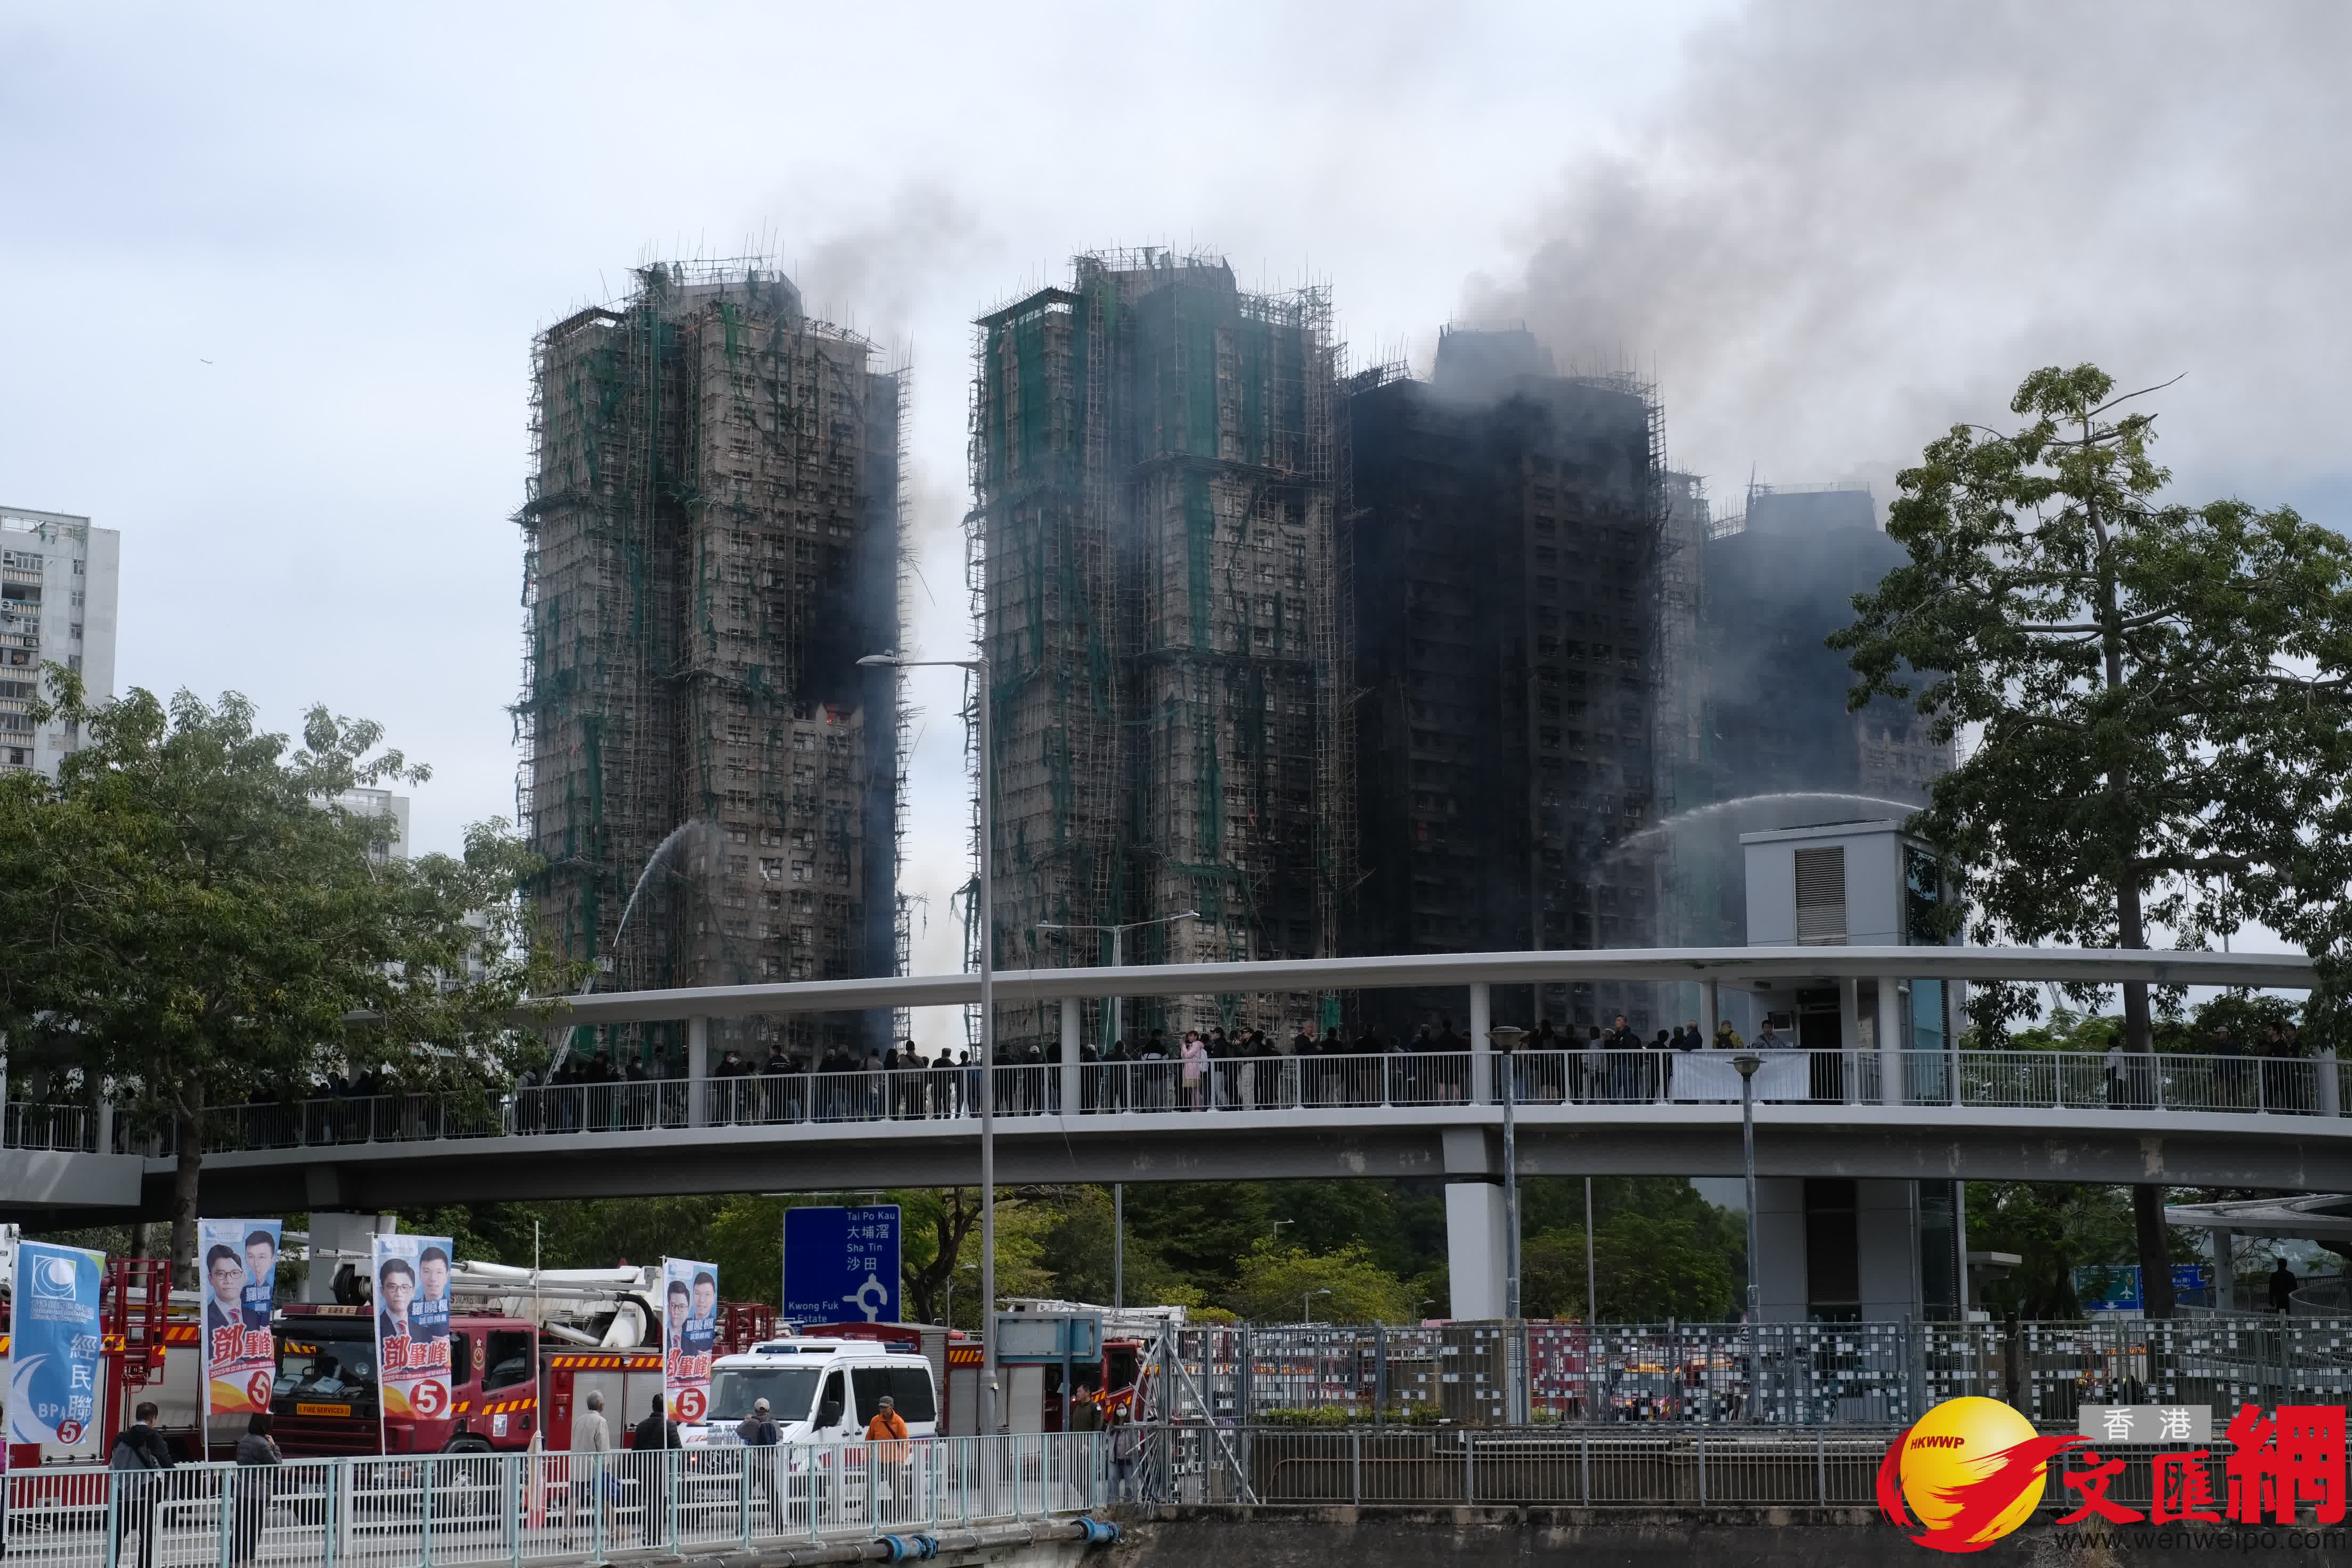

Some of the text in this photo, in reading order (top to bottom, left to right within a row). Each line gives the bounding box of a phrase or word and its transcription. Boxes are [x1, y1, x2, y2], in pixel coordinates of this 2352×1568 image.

[847, 1211, 895, 1221] Tai Po Kau
[847, 1224, 889, 1239] 大埔滘
[847, 1244, 864, 1252] Sha
[847, 1256, 877, 1271] 沙田
[788, 1301, 839, 1311] Kwong Fuk
[798, 1314, 827, 1323] Estate
[383, 1335, 448, 1370] 鄧肇峰
[68, 1333, 98, 1421] 經民聯
[252, 1374, 269, 1404] 5
[416, 1384, 437, 1413] 5
[682, 1392, 699, 1417] 5
[38, 1403, 65, 1419] BPA
[61, 1422, 77, 1442] 5
